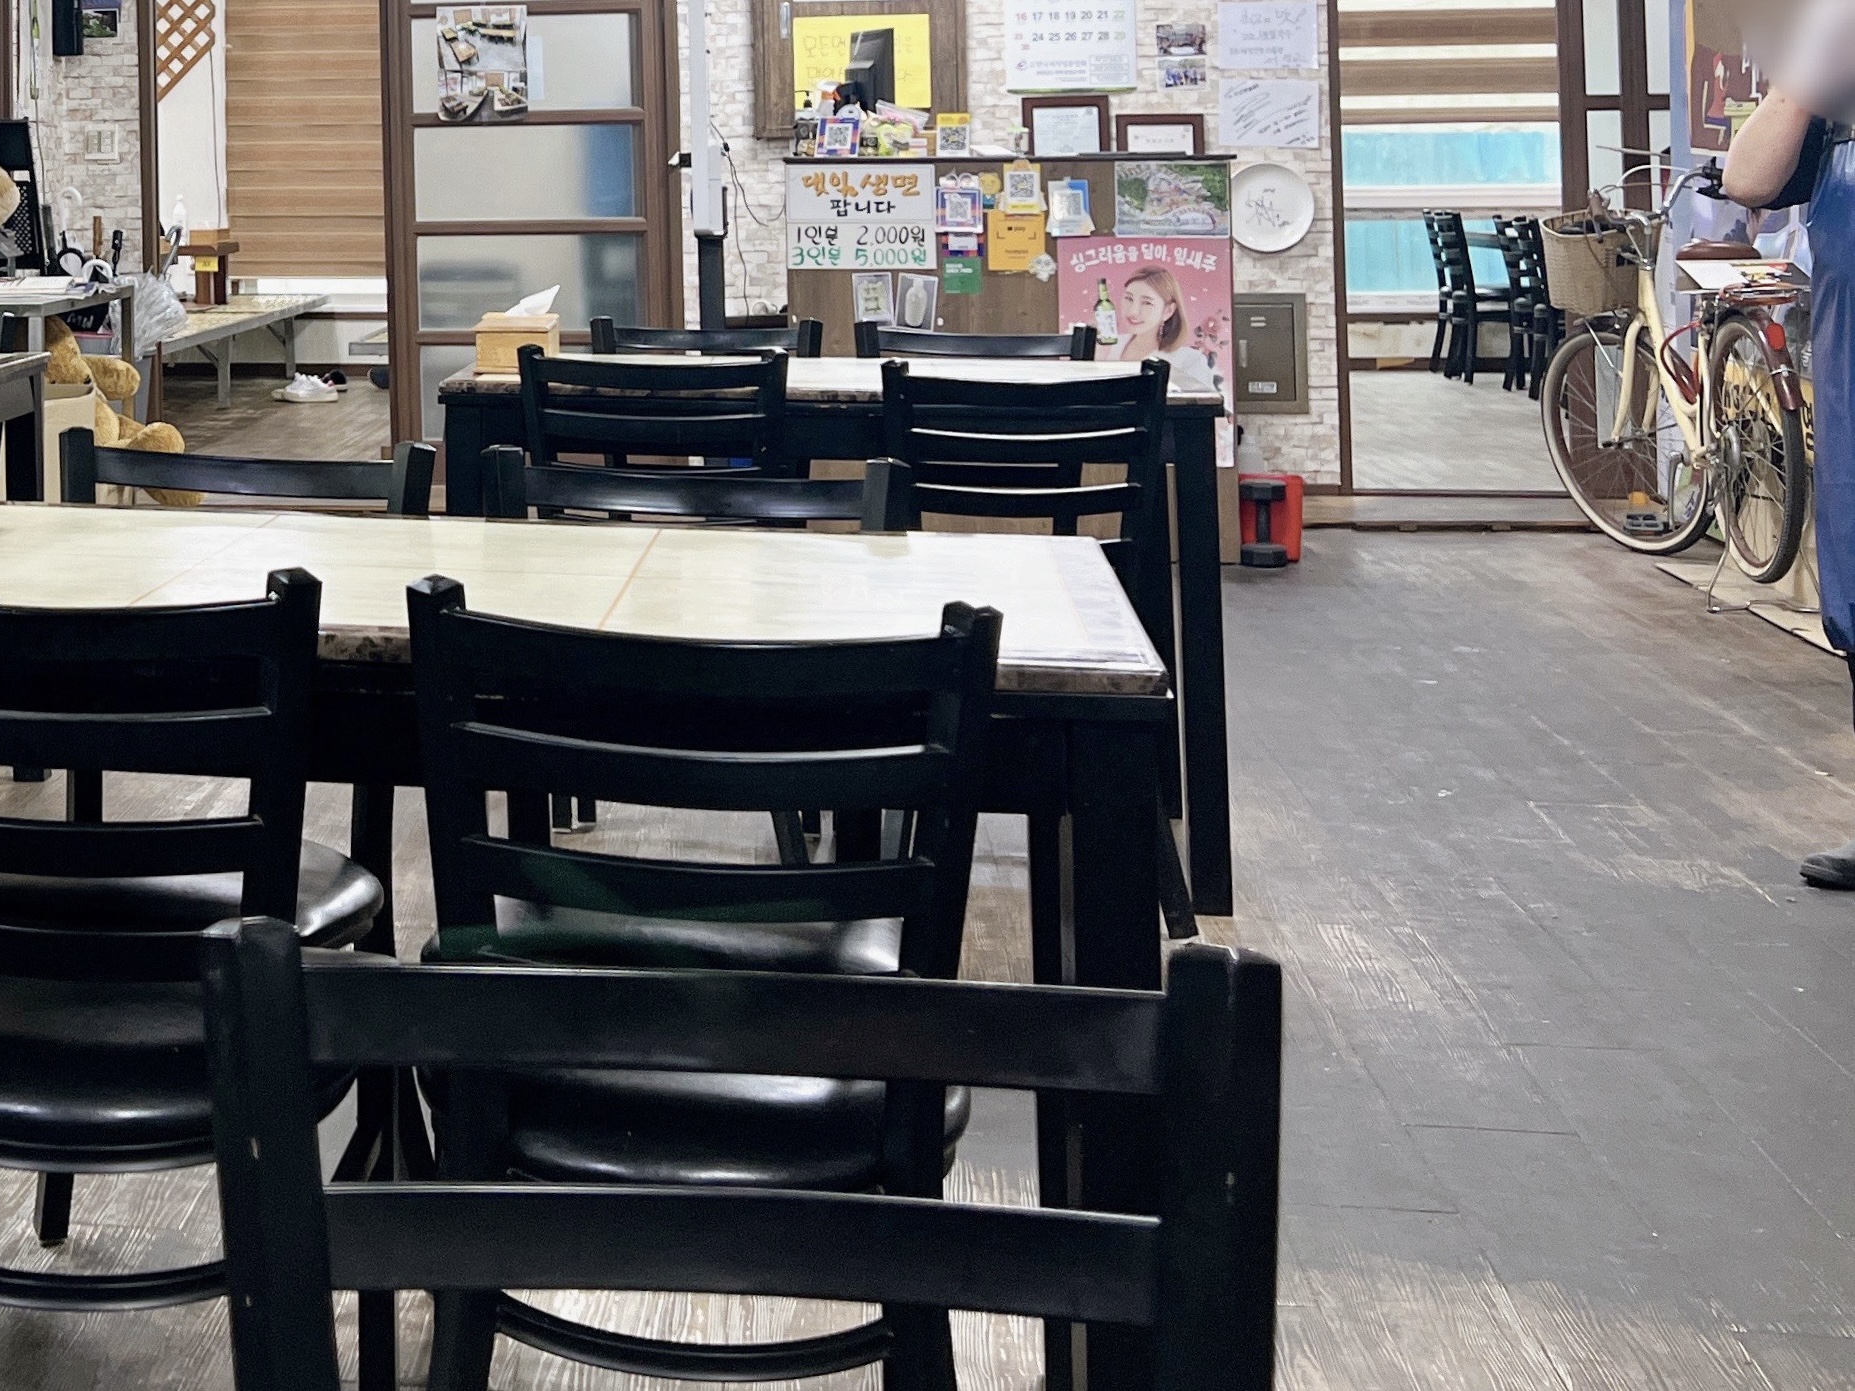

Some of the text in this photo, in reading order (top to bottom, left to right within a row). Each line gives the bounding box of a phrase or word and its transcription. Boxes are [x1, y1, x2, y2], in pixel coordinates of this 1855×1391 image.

[1032, 12, 1043, 20] 17
[1049, 12, 1059, 20] 18
[1065, 11, 1075, 19] 19
[1081, 11, 1092, 19] 20
[1097, 11, 1108, 19] 21
[1032, 33, 1043, 41] 24
[1049, 33, 1060, 41] 25
[1065, 32, 1076, 40] 26
[1082, 32, 1093, 40] 27
[1098, 32, 1109, 40] 28
[830, 198, 896, 217] 팝니다
[797, 225, 839, 246] 1인분
[792, 246, 841, 266] 3인분
[1070, 244, 1139, 273] 싱그러움을
[1174, 247, 1218, 273] 잎새주
